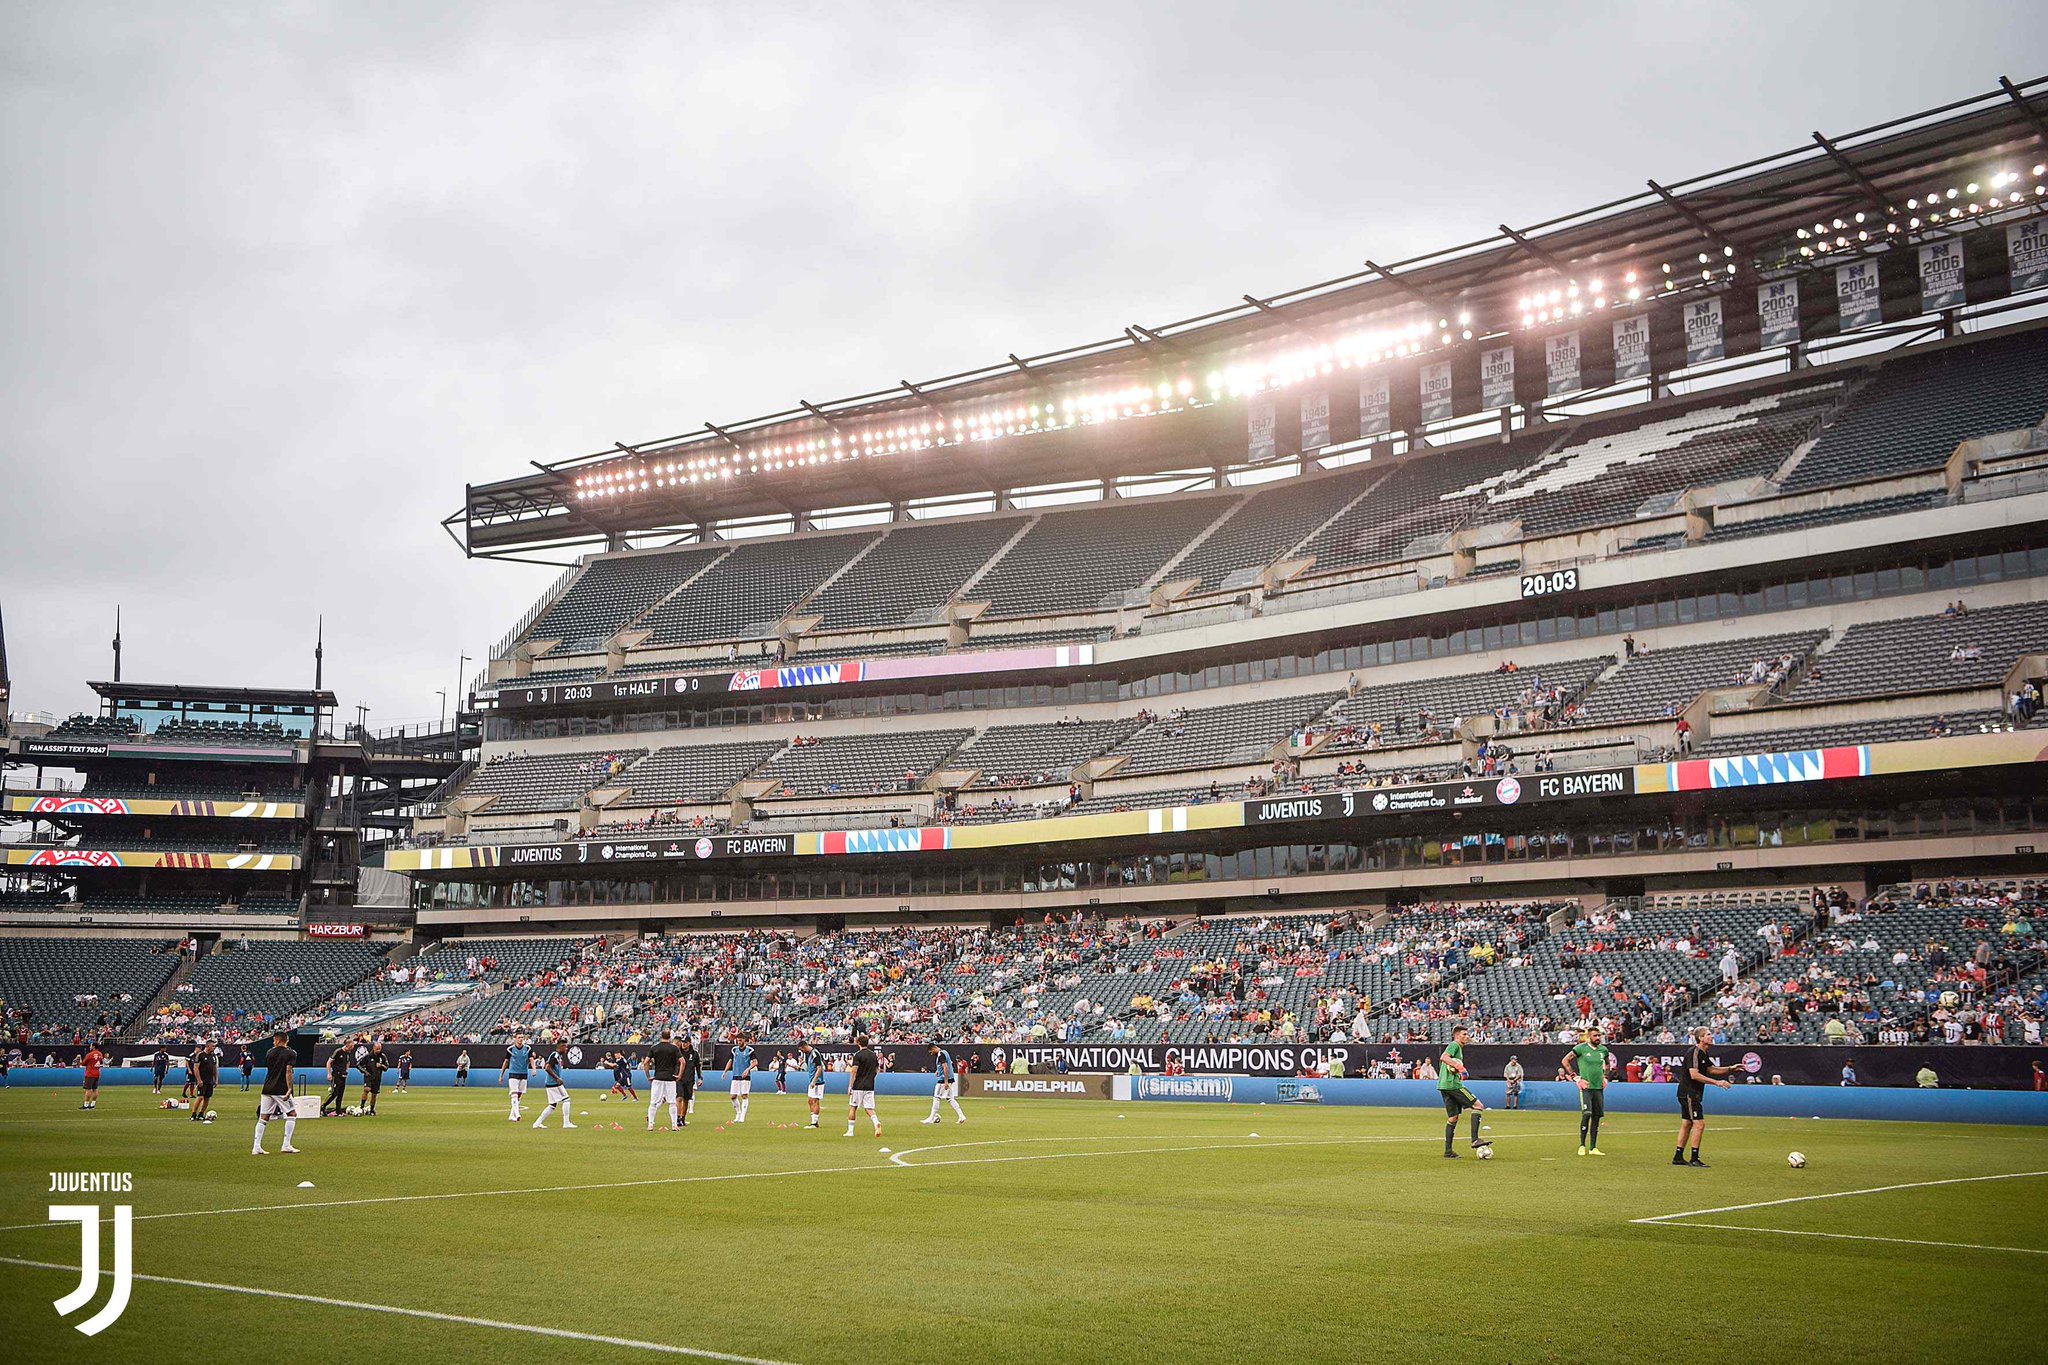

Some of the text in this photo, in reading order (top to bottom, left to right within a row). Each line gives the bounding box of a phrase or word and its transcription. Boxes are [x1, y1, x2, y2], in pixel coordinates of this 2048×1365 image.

[2012, 234, 2048, 254] 2010
[1923, 255, 1960, 275] 2006
[1925, 270, 1959, 283] NFC EAST
[1928, 278, 1957, 290] DIVISION
[1841, 275, 1875, 295] 2004
[1923, 283, 1963, 298] CHAMPIONS
[1762, 294, 1795, 313] 2003
[1688, 312, 1718, 330] 2002
[1761, 320, 1798, 335] CHAMPIONS
[1618, 331, 1645, 346] 2001
[1687, 338, 1722, 352] CHAMPIONS
[1551, 347, 1576, 362] 1988
[1485, 362, 1511, 377] 1980
[1424, 377, 1448, 392] 1960
[1363, 392, 1386, 407] 1949
[1304, 405, 1327, 420] 1948
[1522, 570, 1577, 597] 20:03
[526, 690, 533, 703] 0
[564, 687, 592, 700] 20:03
[629, 681, 658, 696] HALF
[691, 678, 699, 691] 0
[29, 744, 43, 752] FAN
[86, 746, 107, 754] 78247
[1540, 778, 1560, 797] FC
[1563, 773, 1624, 795] BAYERN
[1390, 789, 1434, 801] International
[1258, 799, 1322, 821] JUVENTUS
[1390, 797, 1446, 811] Champions Cup
[615, 843, 649, 852] International
[727, 840, 741, 854] FC
[743, 838, 786, 854] BAYERN
[511, 847, 562, 863] JUVENTUS
[615, 850, 657, 860] Champions Cup
[1165, 1047, 1294, 1070] CHAMPIONS
[983, 1080, 1086, 1093] PHILADELPHIA
